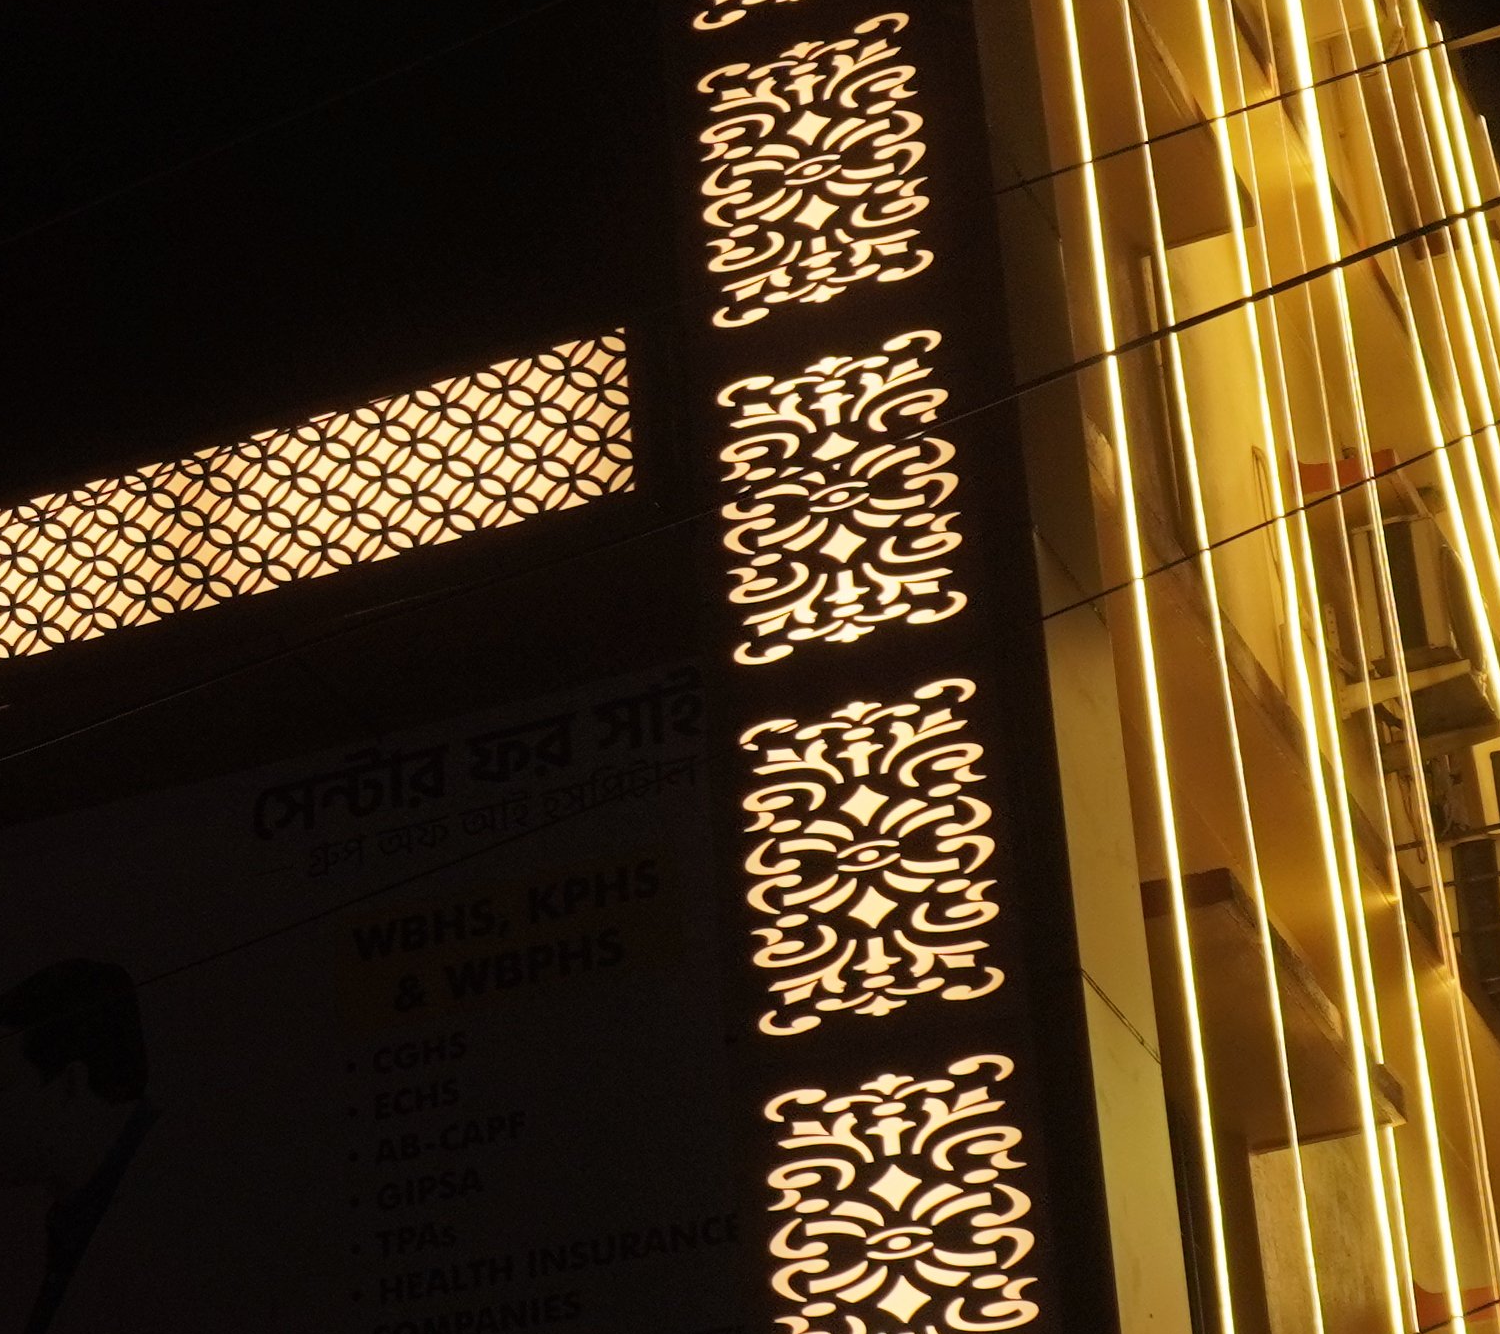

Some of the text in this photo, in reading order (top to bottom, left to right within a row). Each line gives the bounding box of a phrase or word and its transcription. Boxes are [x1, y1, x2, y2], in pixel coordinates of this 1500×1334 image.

[352, 858, 661, 962] WBHS, KPHS
[394, 927, 627, 1014] & WBPHS
[372, 1031, 467, 1075] CGHS
[374, 1078, 460, 1121] ECHS
[377, 1168, 485, 1211] GIPSA
[379, 1212, 742, 1306] HEALTH INSURANCE
